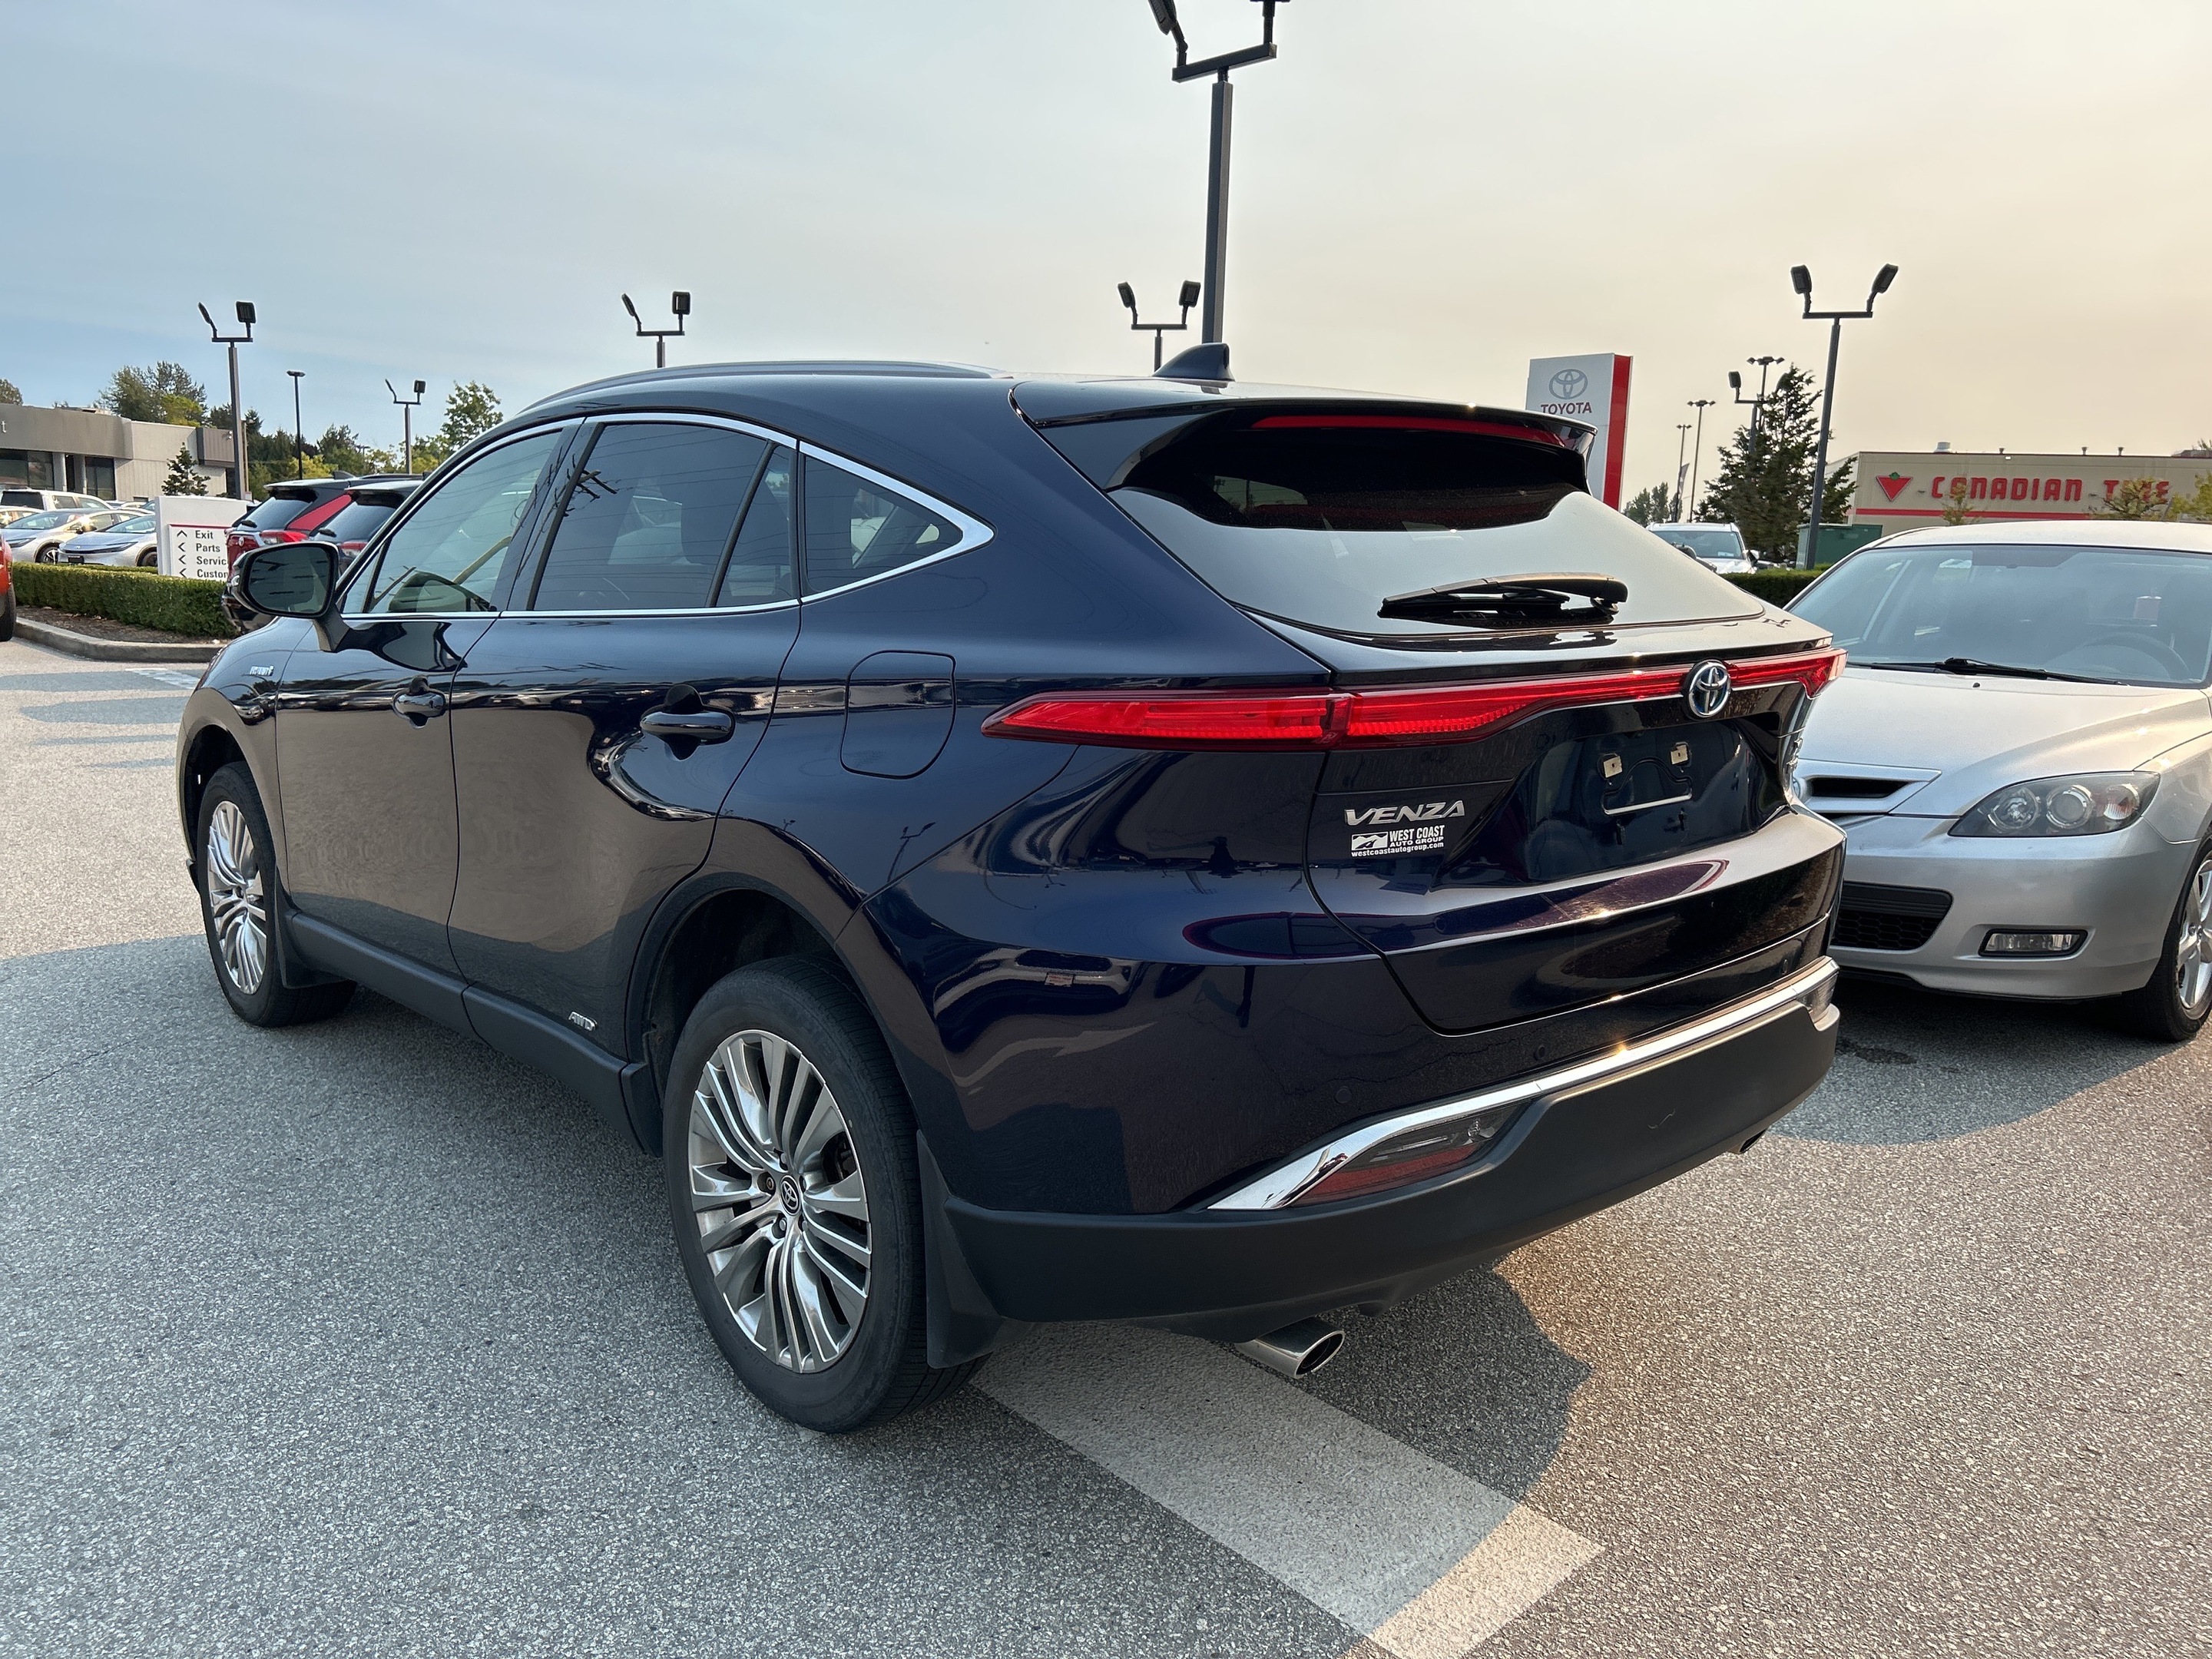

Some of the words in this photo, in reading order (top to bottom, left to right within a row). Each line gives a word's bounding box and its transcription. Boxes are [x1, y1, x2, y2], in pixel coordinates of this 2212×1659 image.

[1541, 402, 1592, 415] TOYOTA
[1931, 476, 2083, 502] CANADIAN
[195, 530, 214, 539] Exit
[196, 543, 220, 552] Parts
[1345, 800, 1465, 826] VENZA
[1389, 829, 1415, 843] WEST
[1416, 825, 1445, 839] COAST
[1415, 836, 1444, 845] GROUP
[1351, 843, 1444, 856] westcoastautogroup.com
